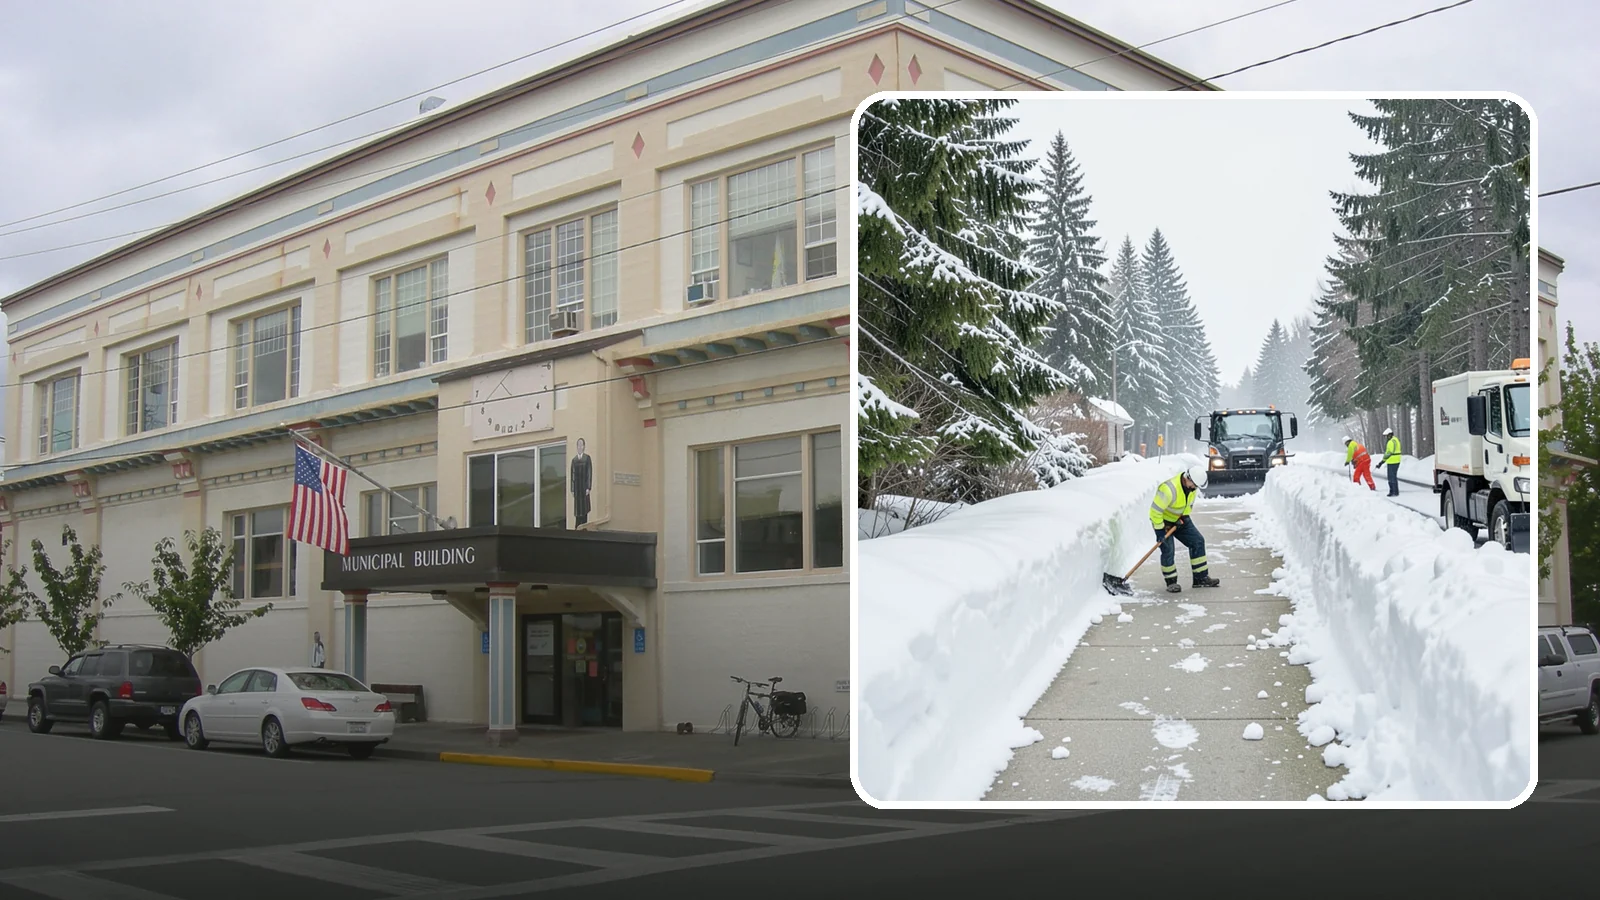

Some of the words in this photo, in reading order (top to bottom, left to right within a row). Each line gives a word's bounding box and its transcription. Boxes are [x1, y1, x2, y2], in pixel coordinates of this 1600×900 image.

[475, 390, 479, 398] 7
[481, 407, 485, 415] 8
[488, 417, 493, 426] 9
[495, 424, 500, 432] 10
[501, 425, 506, 433] 11
[507, 425, 514, 433] 12
[521, 420, 526, 428] 2
[529, 414, 533, 422] 3
[536, 402, 540, 410] 4
[342, 553, 405, 572] MUNICIPAL
[414, 546, 475, 567] BUILDING
